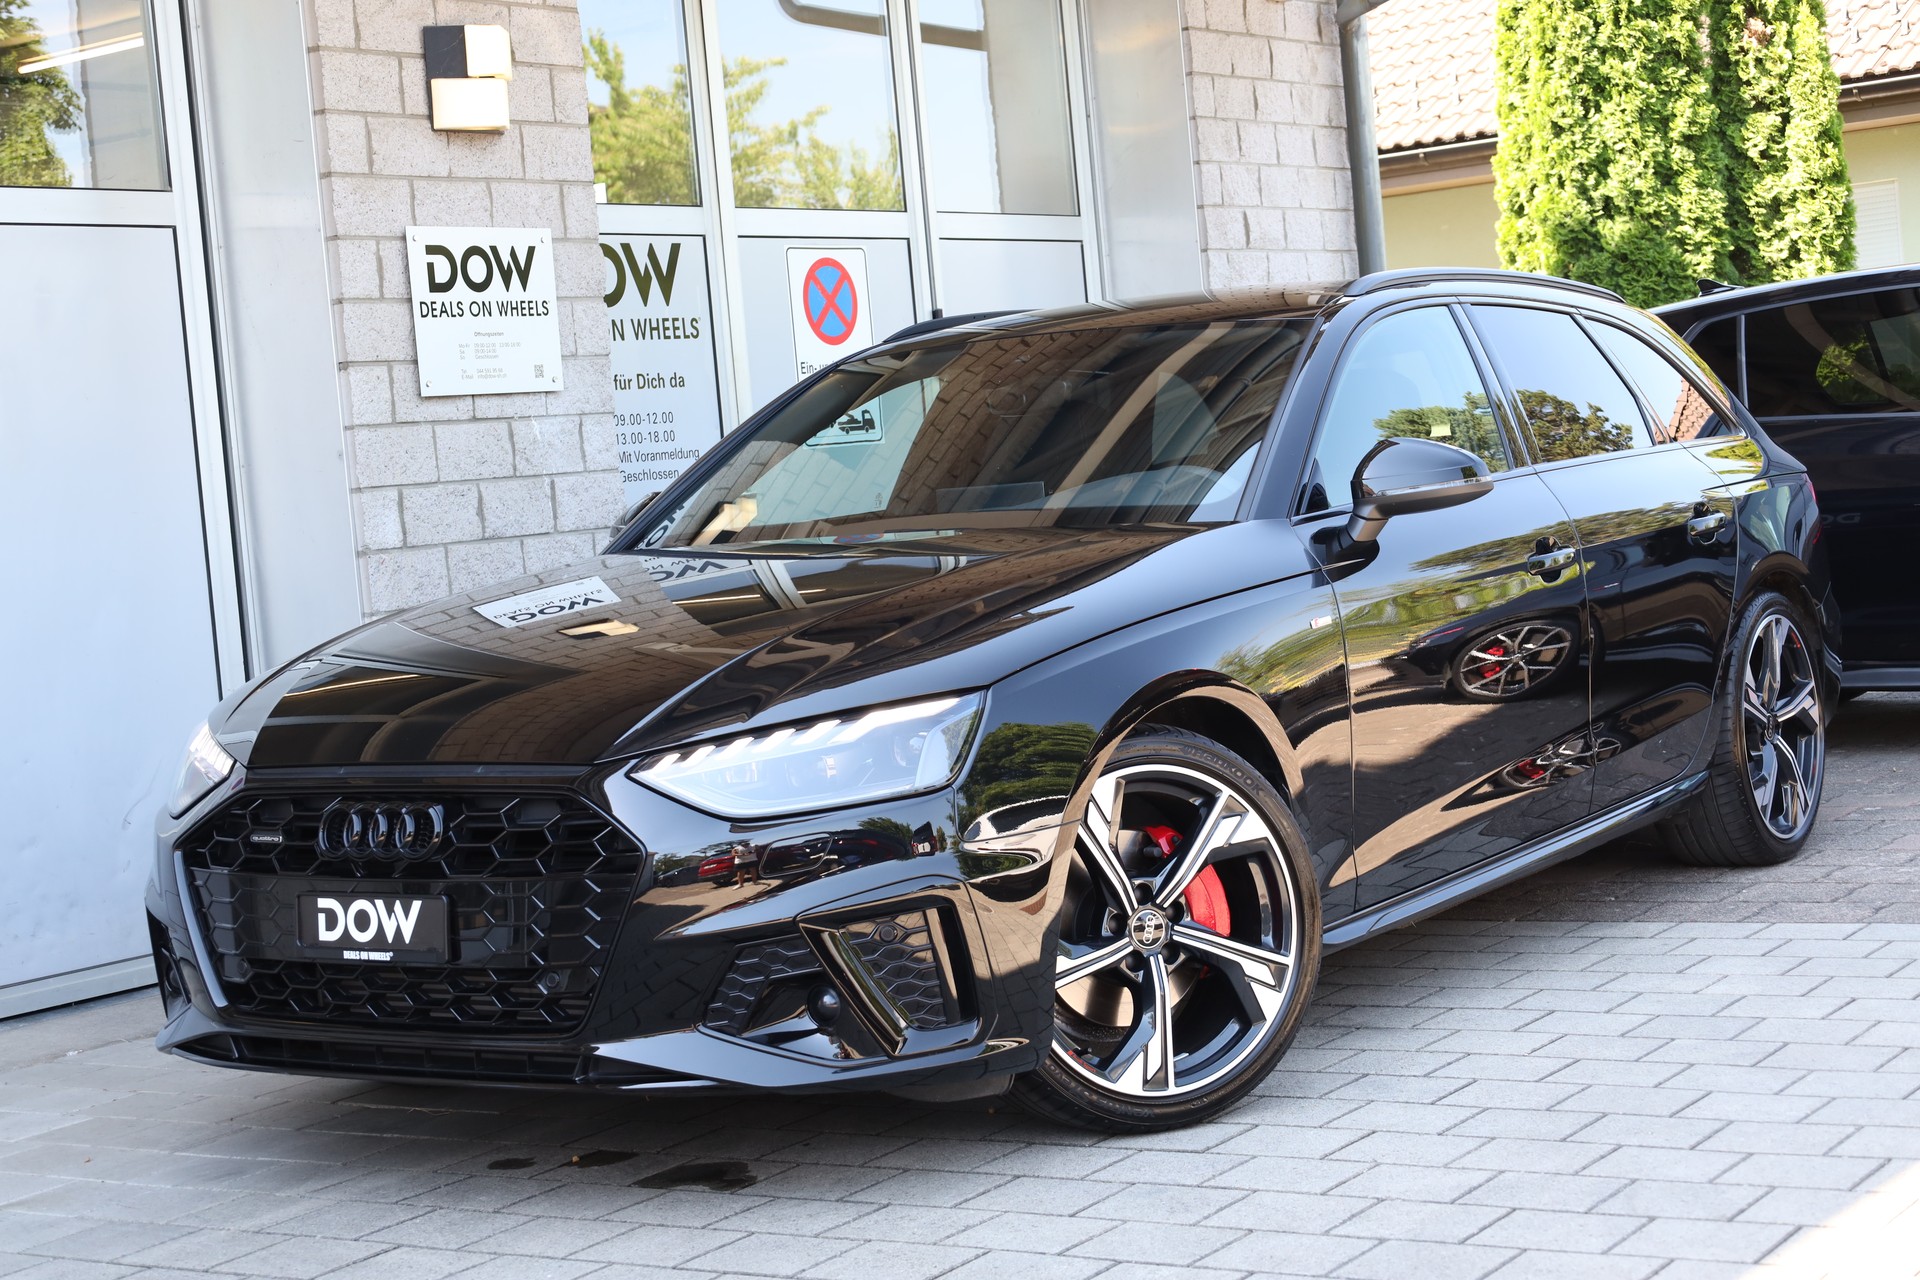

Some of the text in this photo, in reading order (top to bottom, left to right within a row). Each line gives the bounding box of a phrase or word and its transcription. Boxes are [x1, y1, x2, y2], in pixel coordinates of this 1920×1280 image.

[425, 244, 536, 293] DOW
[419, 300, 549, 318] DEALS ON WHEELS
[609, 317, 699, 341] N WHEELS
[613, 372, 685, 390] für Dich da
[613, 411, 674, 427] 09.00-12.00
[616, 430, 676, 446] 13.00-18.00
[634, 447, 700, 462] Voranmeldung
[252, 835, 280, 843] quattro
[317, 897, 422, 944] DOW
